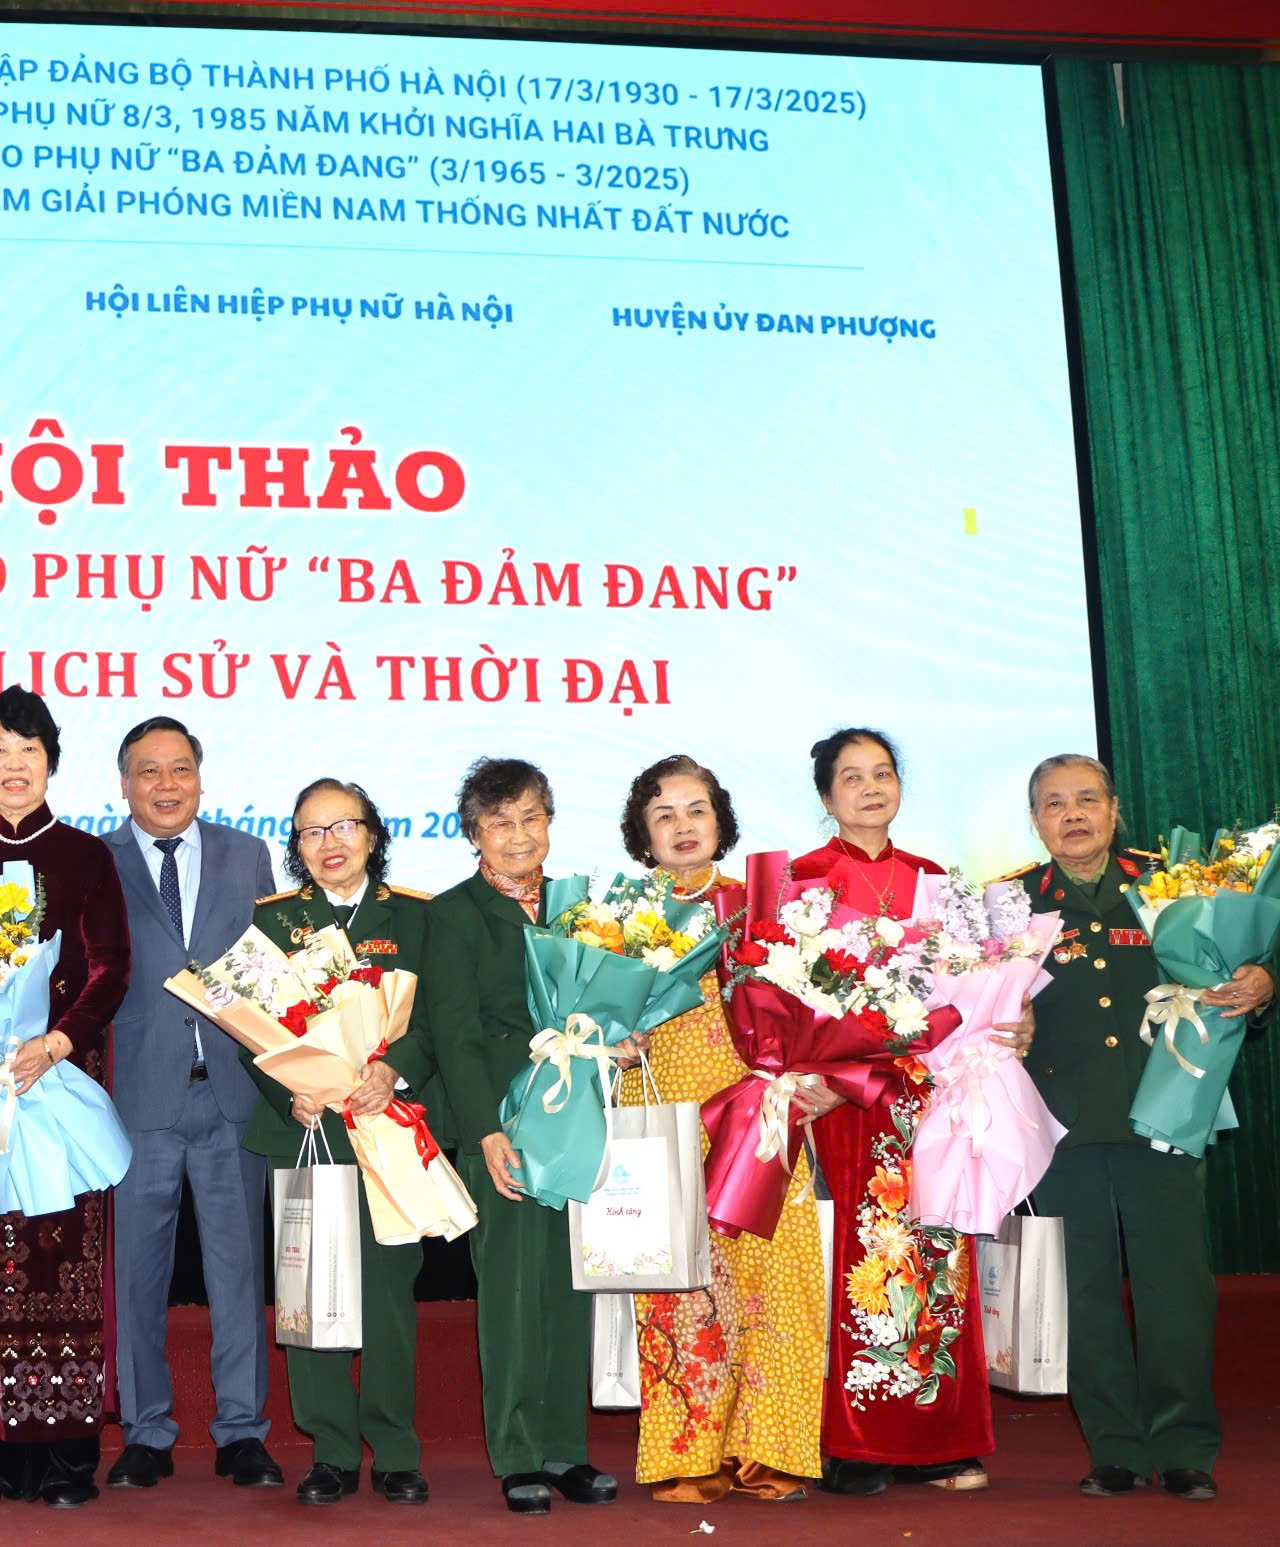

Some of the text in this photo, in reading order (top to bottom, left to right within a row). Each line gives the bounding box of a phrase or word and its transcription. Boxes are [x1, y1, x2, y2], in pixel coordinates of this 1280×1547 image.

[47, 52, 139, 86] ĐẢNG
[149, 57, 193, 92] BỘ
[200, 59, 314, 91] THÀNH
[324, 63, 391, 93] PHỐ
[400, 66, 445, 96] HÀ
[453, 68, 507, 103] NỘI
[516, 74, 679, 107] (17/3/1930
[708, 85, 867, 121] 17/3/2025)
[66, 97, 116, 127] NỮ
[122, 103, 181, 134] 8/3,
[191, 106, 267, 132] 1985
[276, 104, 350, 134] NĂM
[359, 105, 435, 138] KHỞI
[445, 112, 545, 142] NGHĨA
[552, 119, 605, 145] HAI
[614, 117, 656, 147] BÀ
[663, 124, 769, 153] TRƯNG
[33, 145, 101, 175] PHỤ
[110, 141, 161, 172] NỮ
[167, 147, 225, 174] “BA
[232, 143, 307, 177] ĐẢM
[315, 153, 419, 180] ĐANG”
[429, 155, 546, 187] (3/1965
[575, 162, 690, 197] 3/2025)
[41, 181, 106, 214] GIẢI
[116, 186, 232, 217] PHÓNG
[242, 188, 322, 220] MIỀN
[332, 196, 406, 222] NAM
[415, 195, 527, 228] THỐNG
[536, 199, 623, 231] NHẤT
[631, 202, 694, 234] ĐẤT
[702, 207, 790, 239] NƯỚC
[85, 283, 513, 330] HỘI LIÊN HIỆP PHỤ NỮ HÀ NỘI
[612, 300, 937, 345] HUYỆN ỦY ĐAN PHƯỢNG
[163, 425, 467, 514] THẢO
[31, 552, 166, 613] PHỤ
[189, 543, 288, 603] NỮ
[307, 555, 422, 605] “BA
[439, 546, 583, 608] ĐẢM
[601, 563, 798, 612] ĐANG”
[161, 638, 251, 700] SỬ
[269, 640, 358, 701] VÀ
[375, 642, 542, 704] THỜI
[560, 657, 672, 718] ĐẠI
